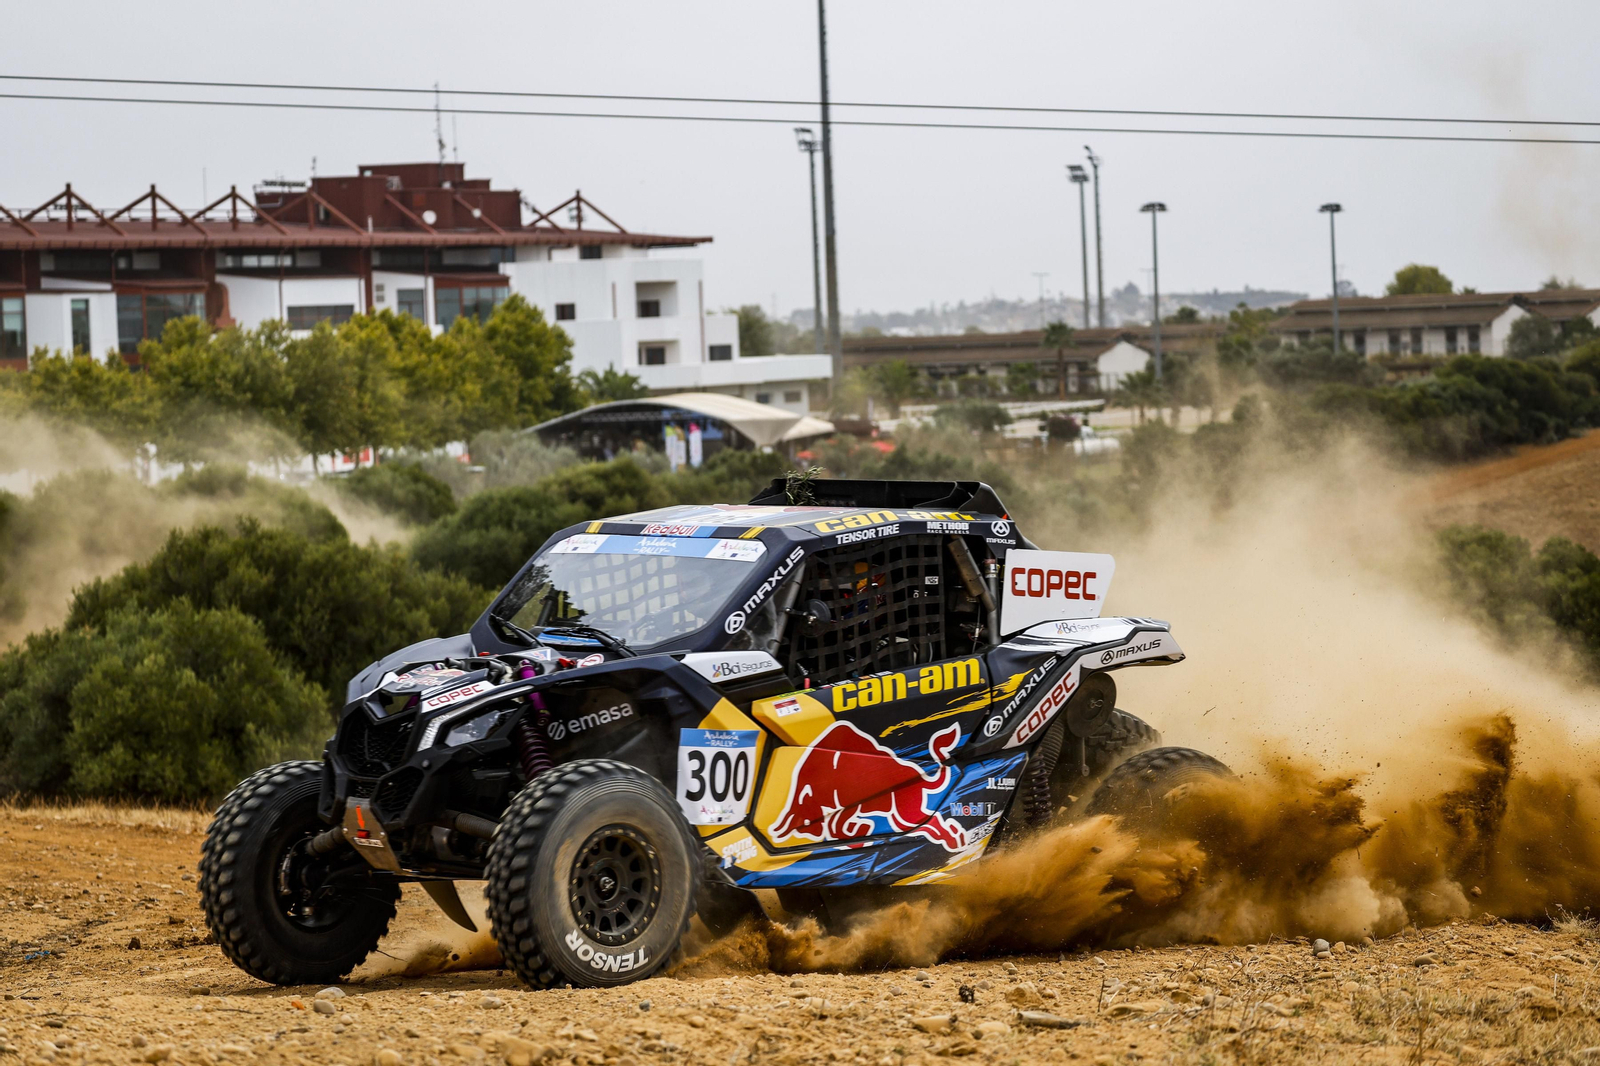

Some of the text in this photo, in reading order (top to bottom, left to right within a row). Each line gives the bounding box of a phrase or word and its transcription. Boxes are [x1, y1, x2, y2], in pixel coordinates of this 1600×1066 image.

[642, 523, 699, 535] Red Bull
[835, 524, 900, 545] TENSOR TIRE
[926, 521, 970, 530] METHOD
[721, 660, 773, 677] Bci Seguros
[568, 702, 634, 734] emasa
[685, 750, 749, 802] 300
[949, 802, 984, 817] Mobil
[722, 836, 753, 856] SOUTH
[565, 928, 649, 973] TENSOR
